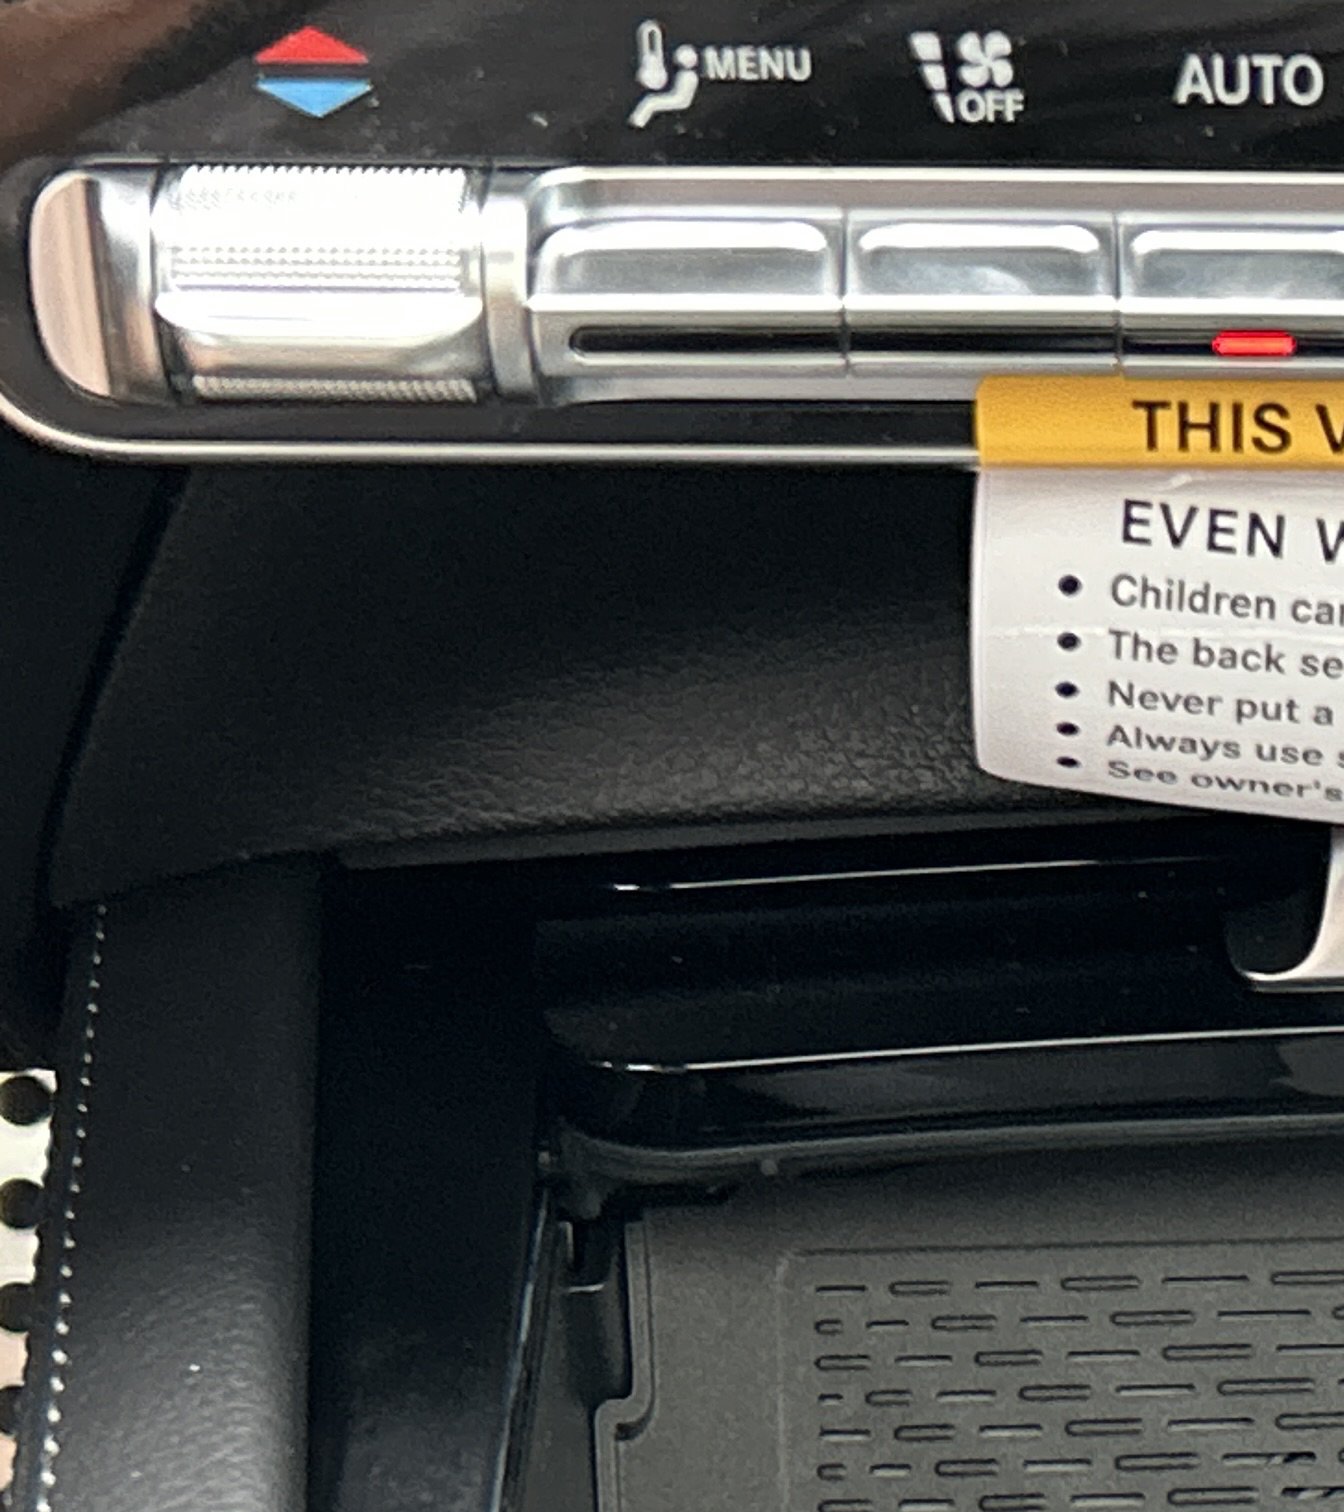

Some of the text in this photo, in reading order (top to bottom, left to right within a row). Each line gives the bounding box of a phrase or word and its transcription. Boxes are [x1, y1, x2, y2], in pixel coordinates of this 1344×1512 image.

[703, 48, 811, 83] MENU
[1174, 56, 1324, 107] AUTO
[958, 91, 1024, 123] OFF
[1133, 400, 1291, 454] THIS
[1121, 499, 1286, 559] EVEN
[1111, 573, 1276, 620] Children
[1108, 631, 1177, 666] The
[1193, 636, 1285, 675] back
[1108, 682, 1223, 718] Never
[1235, 694, 1300, 726] put
[1313, 704, 1333, 727] a
[1106, 724, 1241, 761] Always
[1256, 743, 1322, 767] use
[1108, 761, 1177, 785] See
[1191, 768, 1343, 803] owner's
